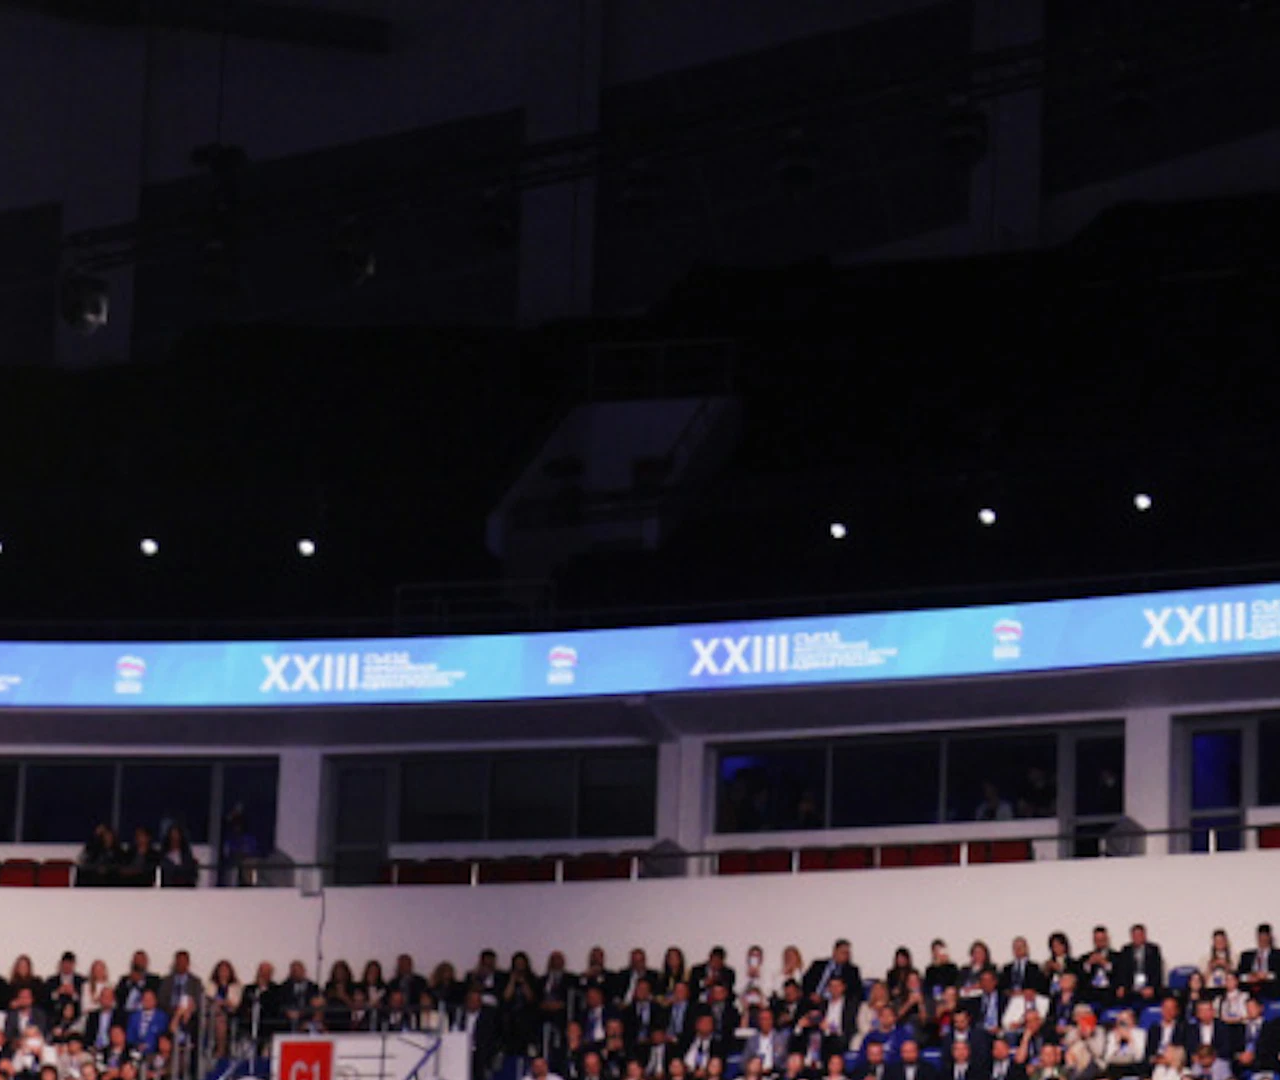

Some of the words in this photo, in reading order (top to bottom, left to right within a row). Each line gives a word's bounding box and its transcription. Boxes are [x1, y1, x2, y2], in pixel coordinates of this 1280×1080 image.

[1142, 601, 1248, 649] XXIII
[259, 652, 361, 693] XXIII
[689, 633, 791, 677] XXIII
